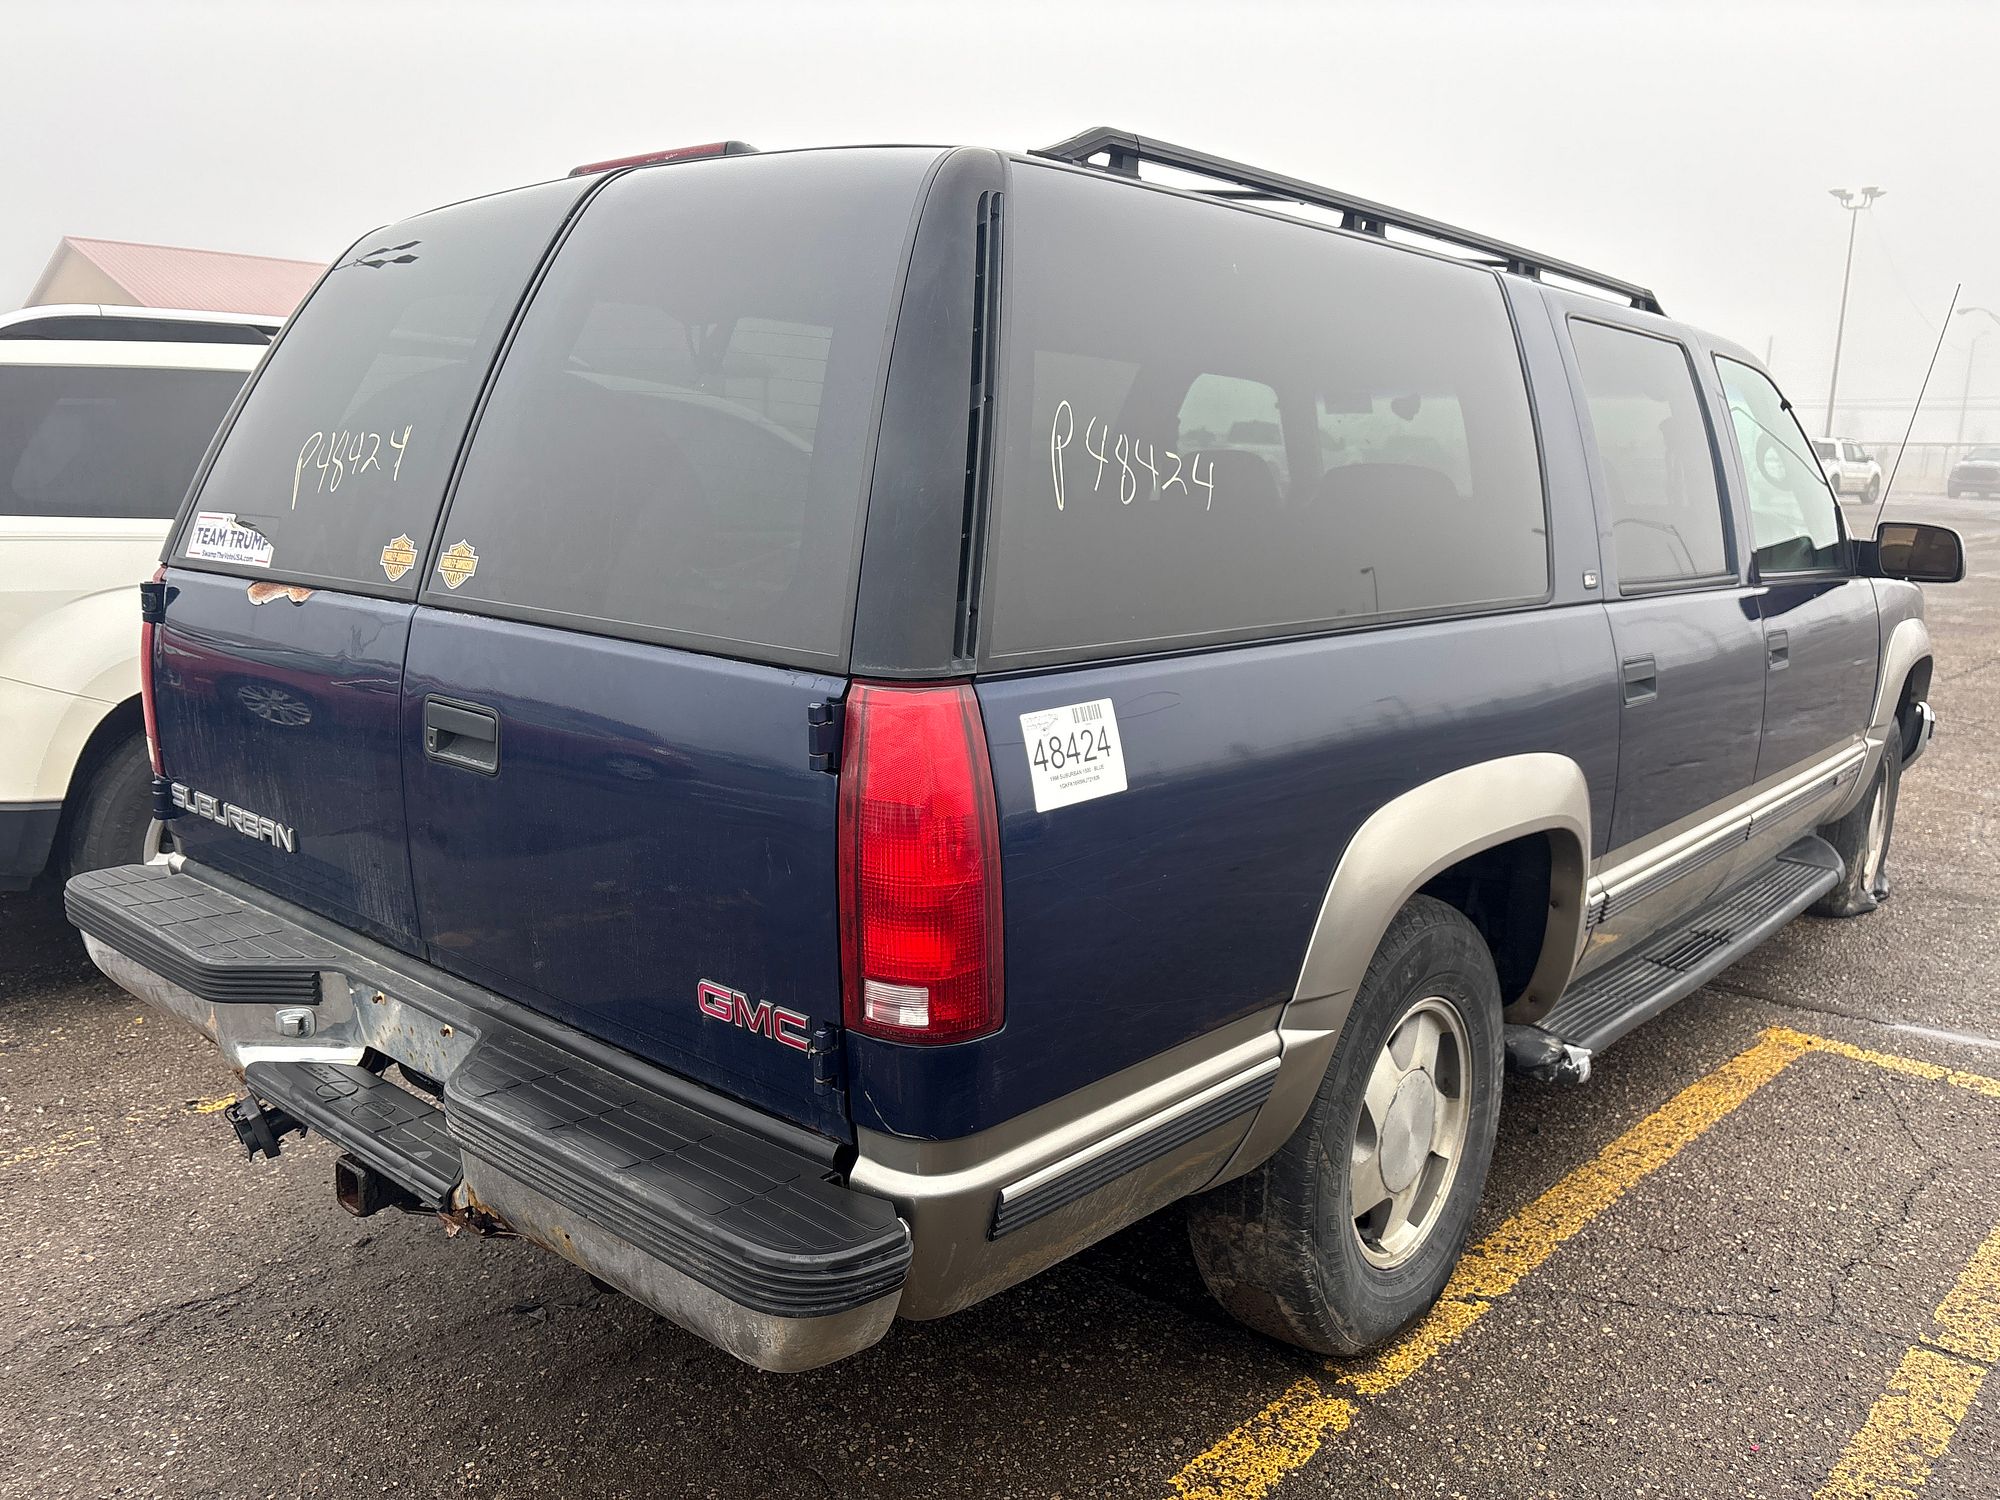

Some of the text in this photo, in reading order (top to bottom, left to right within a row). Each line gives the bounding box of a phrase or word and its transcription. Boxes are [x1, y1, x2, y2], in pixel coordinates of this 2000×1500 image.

[291, 424, 413, 510] P48424
[1051, 400, 1214, 511] P48424
[196, 527, 228, 547] TEAM
[1033, 725, 1111, 772] 48424
[171, 782, 297, 854] SUBURBAN
[697, 978, 812, 1052] GMC
